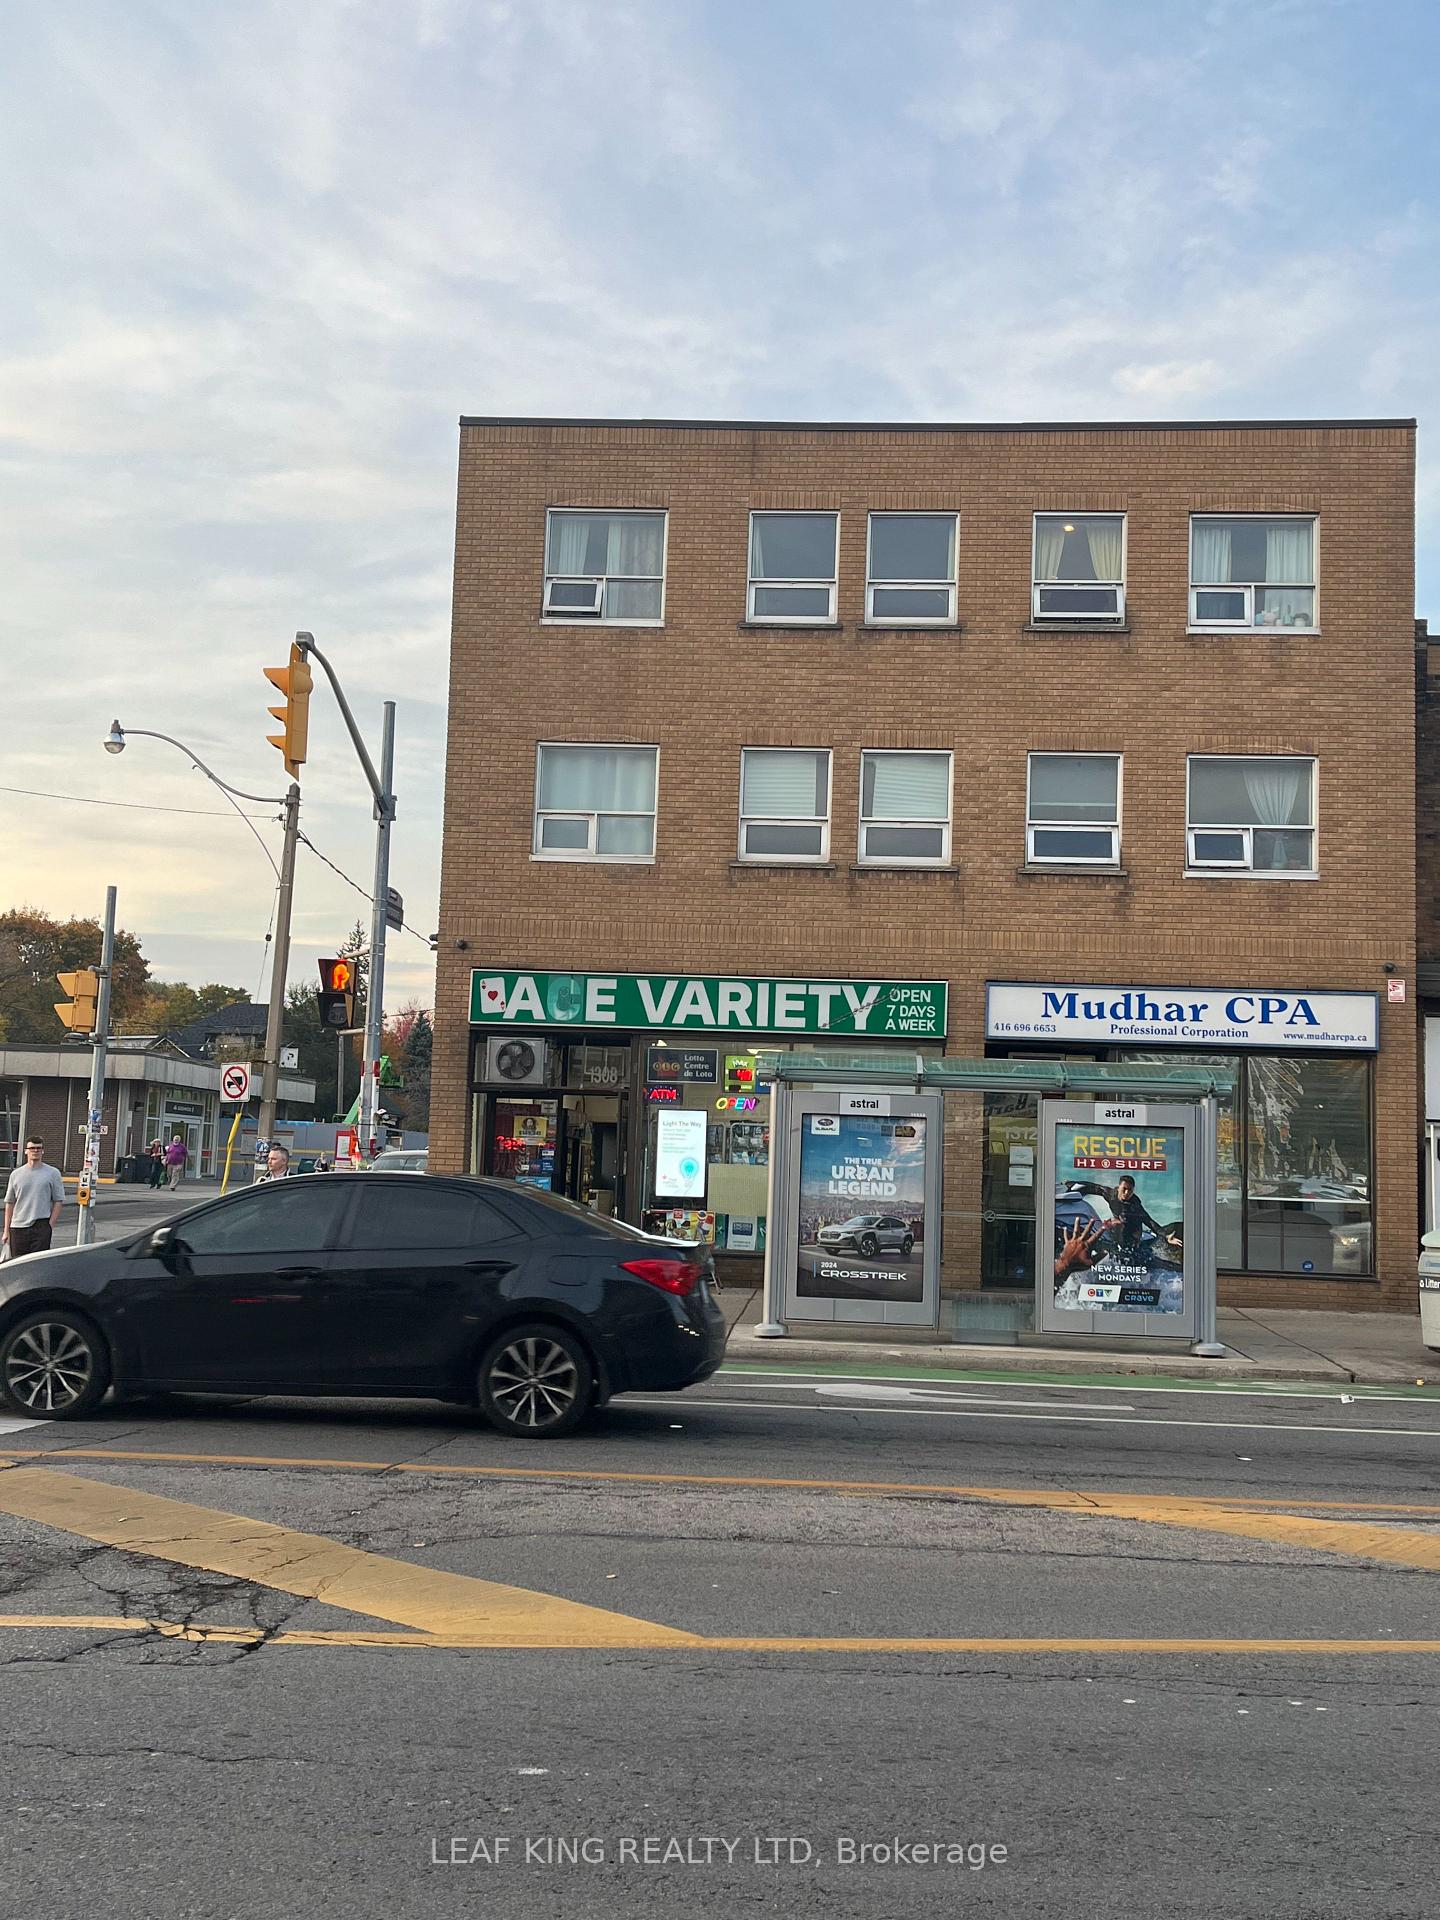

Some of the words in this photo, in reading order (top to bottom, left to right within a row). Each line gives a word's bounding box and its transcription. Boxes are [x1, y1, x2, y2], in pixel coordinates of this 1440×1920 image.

[889, 987, 932, 1004] OPEN
[636, 979, 882, 1030] VARIETY
[1041, 992, 1209, 1022] Mudhar
[1225, 996, 1321, 1026] CPA
[887, 1005, 895, 1017] 7
[899, 1005, 936, 1018] DAYS
[885, 1018, 897, 1030] A
[898, 1018, 936, 1031] WEEK
[994, 1022, 1011, 1031] 416
[1013, 1023, 1031, 1032] 696
[1033, 1024, 1057, 1033] 6653
[1110, 1024, 1177, 1036] Professional
[1181, 1026, 1249, 1039] Corporation
[1283, 1031, 1368, 1042] www.mudharcpa.ca
[684, 1054, 705, 1062] Lotto
[684, 1062, 710, 1070] Centre
[590, 1066, 618, 1084] 1308
[695, 1070, 713, 1078] Loto
[650, 1089, 677, 1100] ATM
[716, 1097, 758, 1110] OPEN
[850, 1099, 879, 1108] astral
[1105, 1109, 1135, 1118] astral
[1073, 1135, 1167, 1158] RESCUE
[861, 1157, 882, 1165] TRUE
[1115, 1160, 1163, 1170] SURF
[831, 1165, 895, 1181] URBAN
[828, 1180, 897, 1196] LEGEND
[820, 1269, 907, 1281] CROSSTREK
[1090, 1265, 1113, 1273] NEW
[1114, 1265, 1148, 1274] SERIES
[1098, 1274, 1142, 1282] MONDAYS
